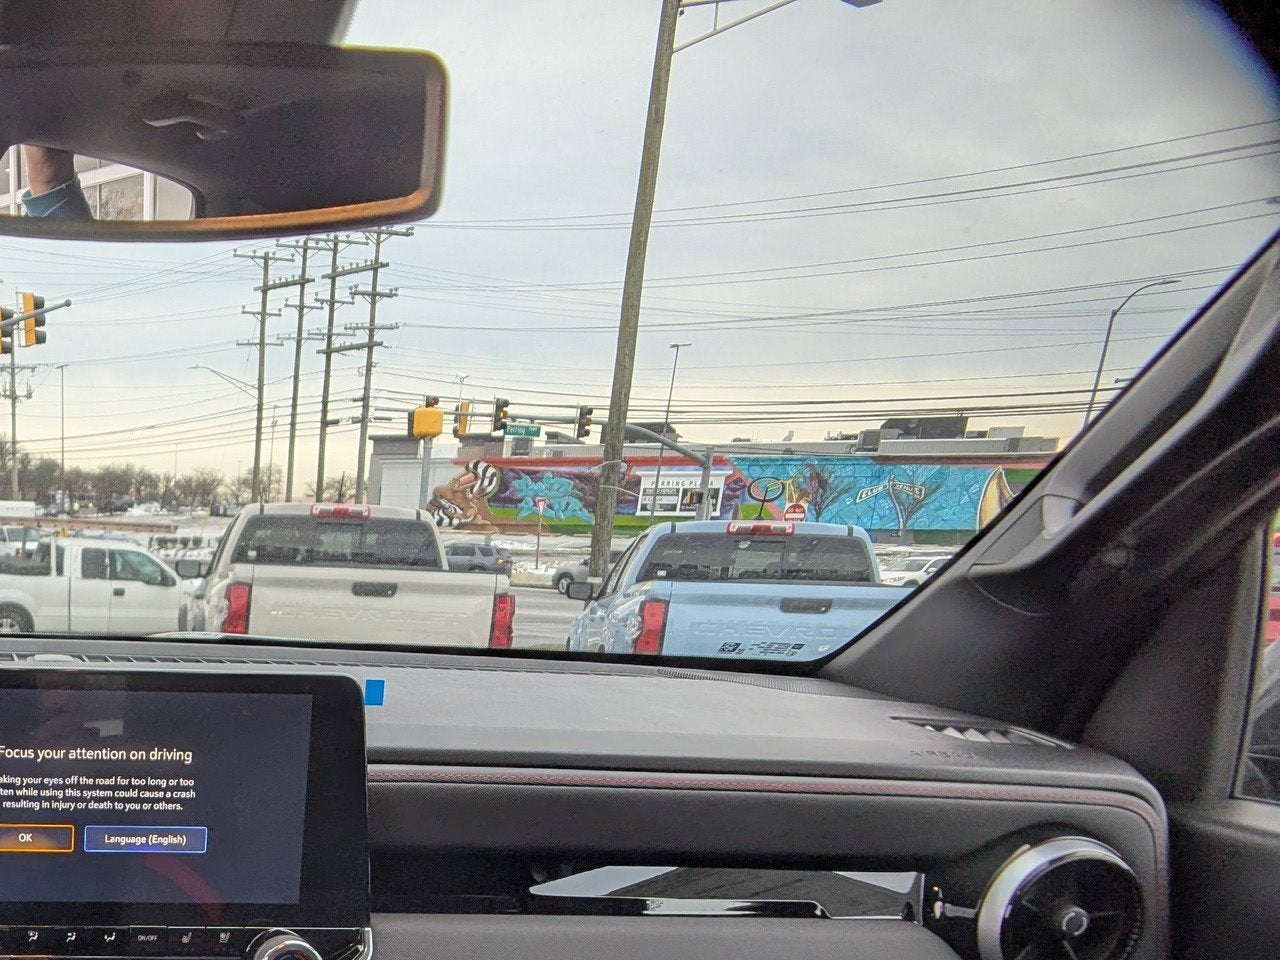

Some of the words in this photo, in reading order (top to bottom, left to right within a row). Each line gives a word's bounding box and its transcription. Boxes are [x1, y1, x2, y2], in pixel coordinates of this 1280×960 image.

[36, 749, 66, 763] your
[68, 747, 126, 760] attention
[129, 751, 146, 760] on
[149, 747, 193, 765] driving
[22, 777, 42, 786] your
[44, 777, 63, 787] eyes
[65, 775, 79, 785] off
[80, 776, 94, 785] the
[95, 776, 115, 785] road
[117, 776, 130, 785] for
[131, 777, 146, 786] too
[147, 777, 167, 788] long
[168, 778, 179, 786] or
[180, 778, 195, 786] too
[15, 787, 38, 796] while
[40, 788, 64, 798] using
[65, 788, 81, 797] this
[82, 789, 113, 799] system
[114, 788, 138, 798] could
[139, 790, 164, 798] cause
[172, 789, 196, 798] crash
[2, 799, 40, 811] resulting
[41, 800, 50, 809] in
[51, 800, 76, 811] injury
[88, 800, 113, 809] death
[114, 801, 124, 809] to
[125, 802, 141, 812] you
[142, 802, 152, 810] or
[153, 801, 184, 811] others.
[18, 833, 33, 843] OK
[104, 834, 147, 845] Language
[148, 834, 187, 846] (English)
